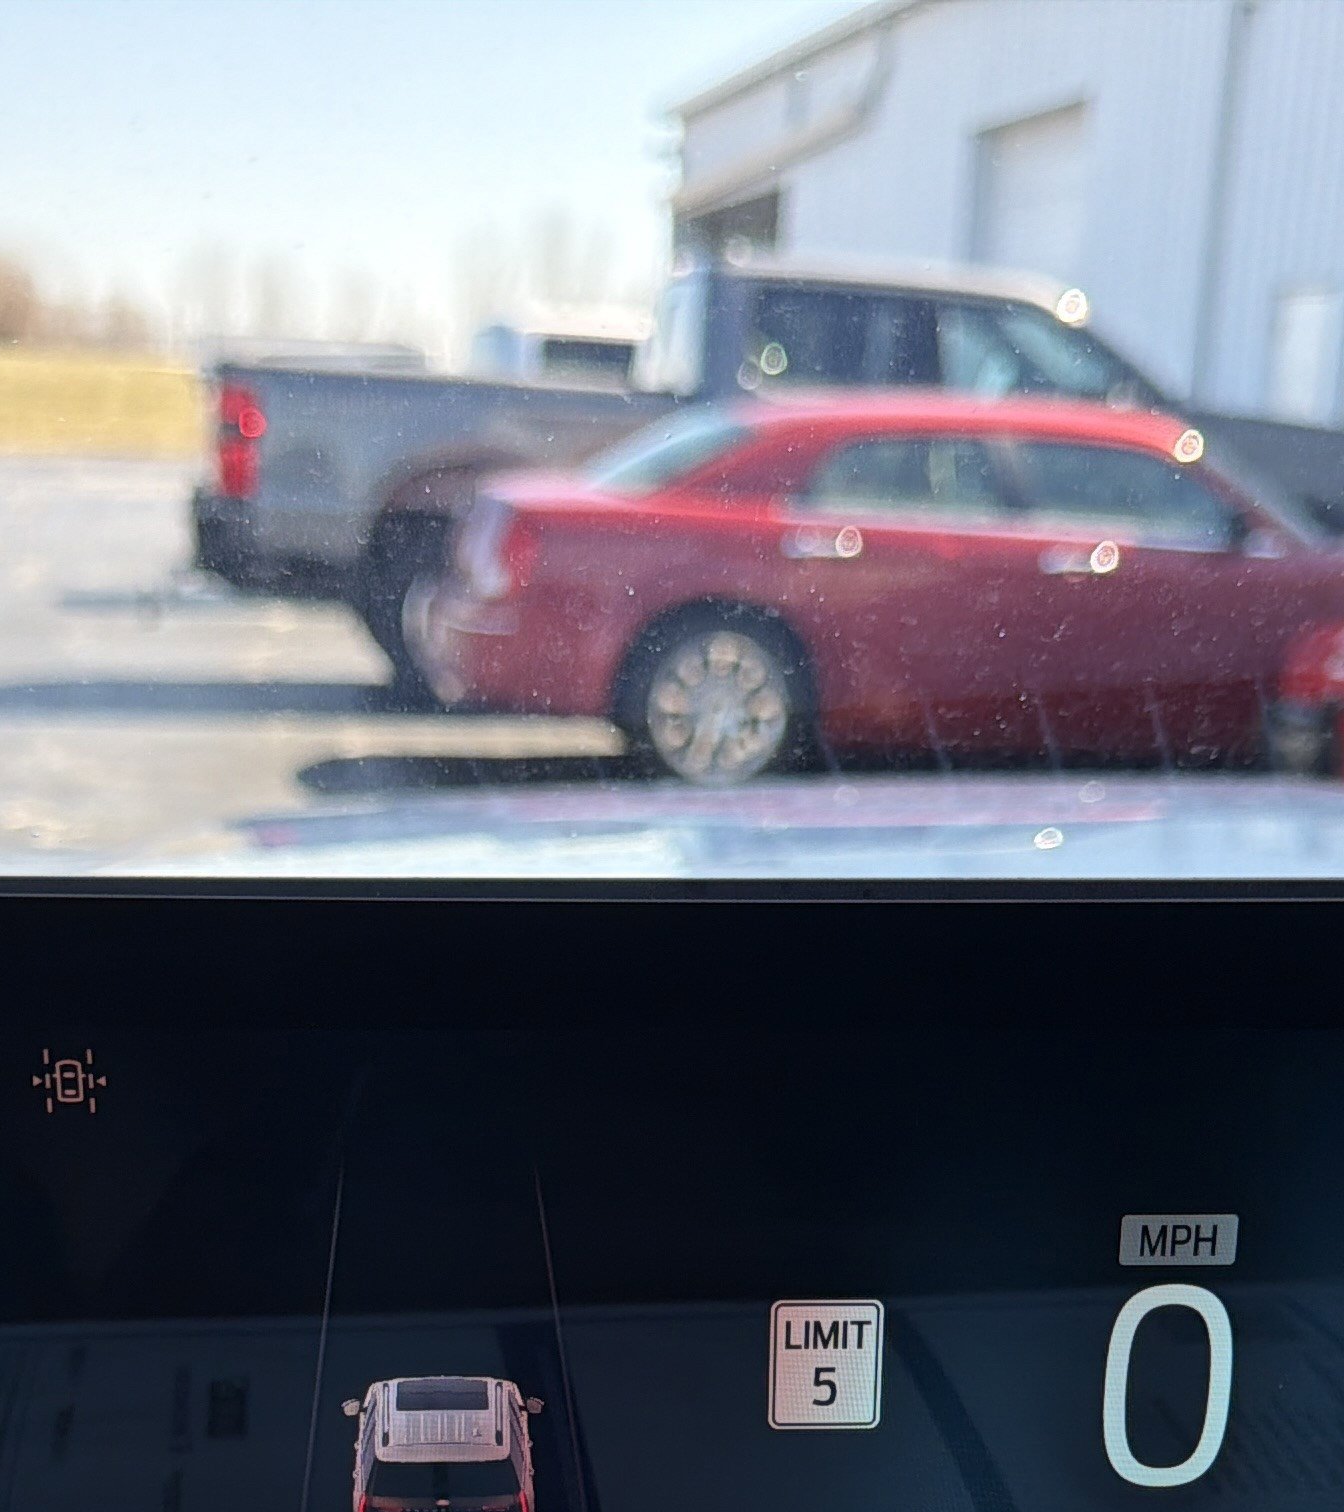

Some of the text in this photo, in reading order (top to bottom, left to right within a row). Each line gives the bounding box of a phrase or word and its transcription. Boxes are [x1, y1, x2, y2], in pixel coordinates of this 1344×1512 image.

[1139, 1225, 1219, 1257] MPH
[784, 1320, 872, 1350] LIMIT
[812, 1367, 838, 1406] 5
[1102, 1283, 1233, 1487] 0
